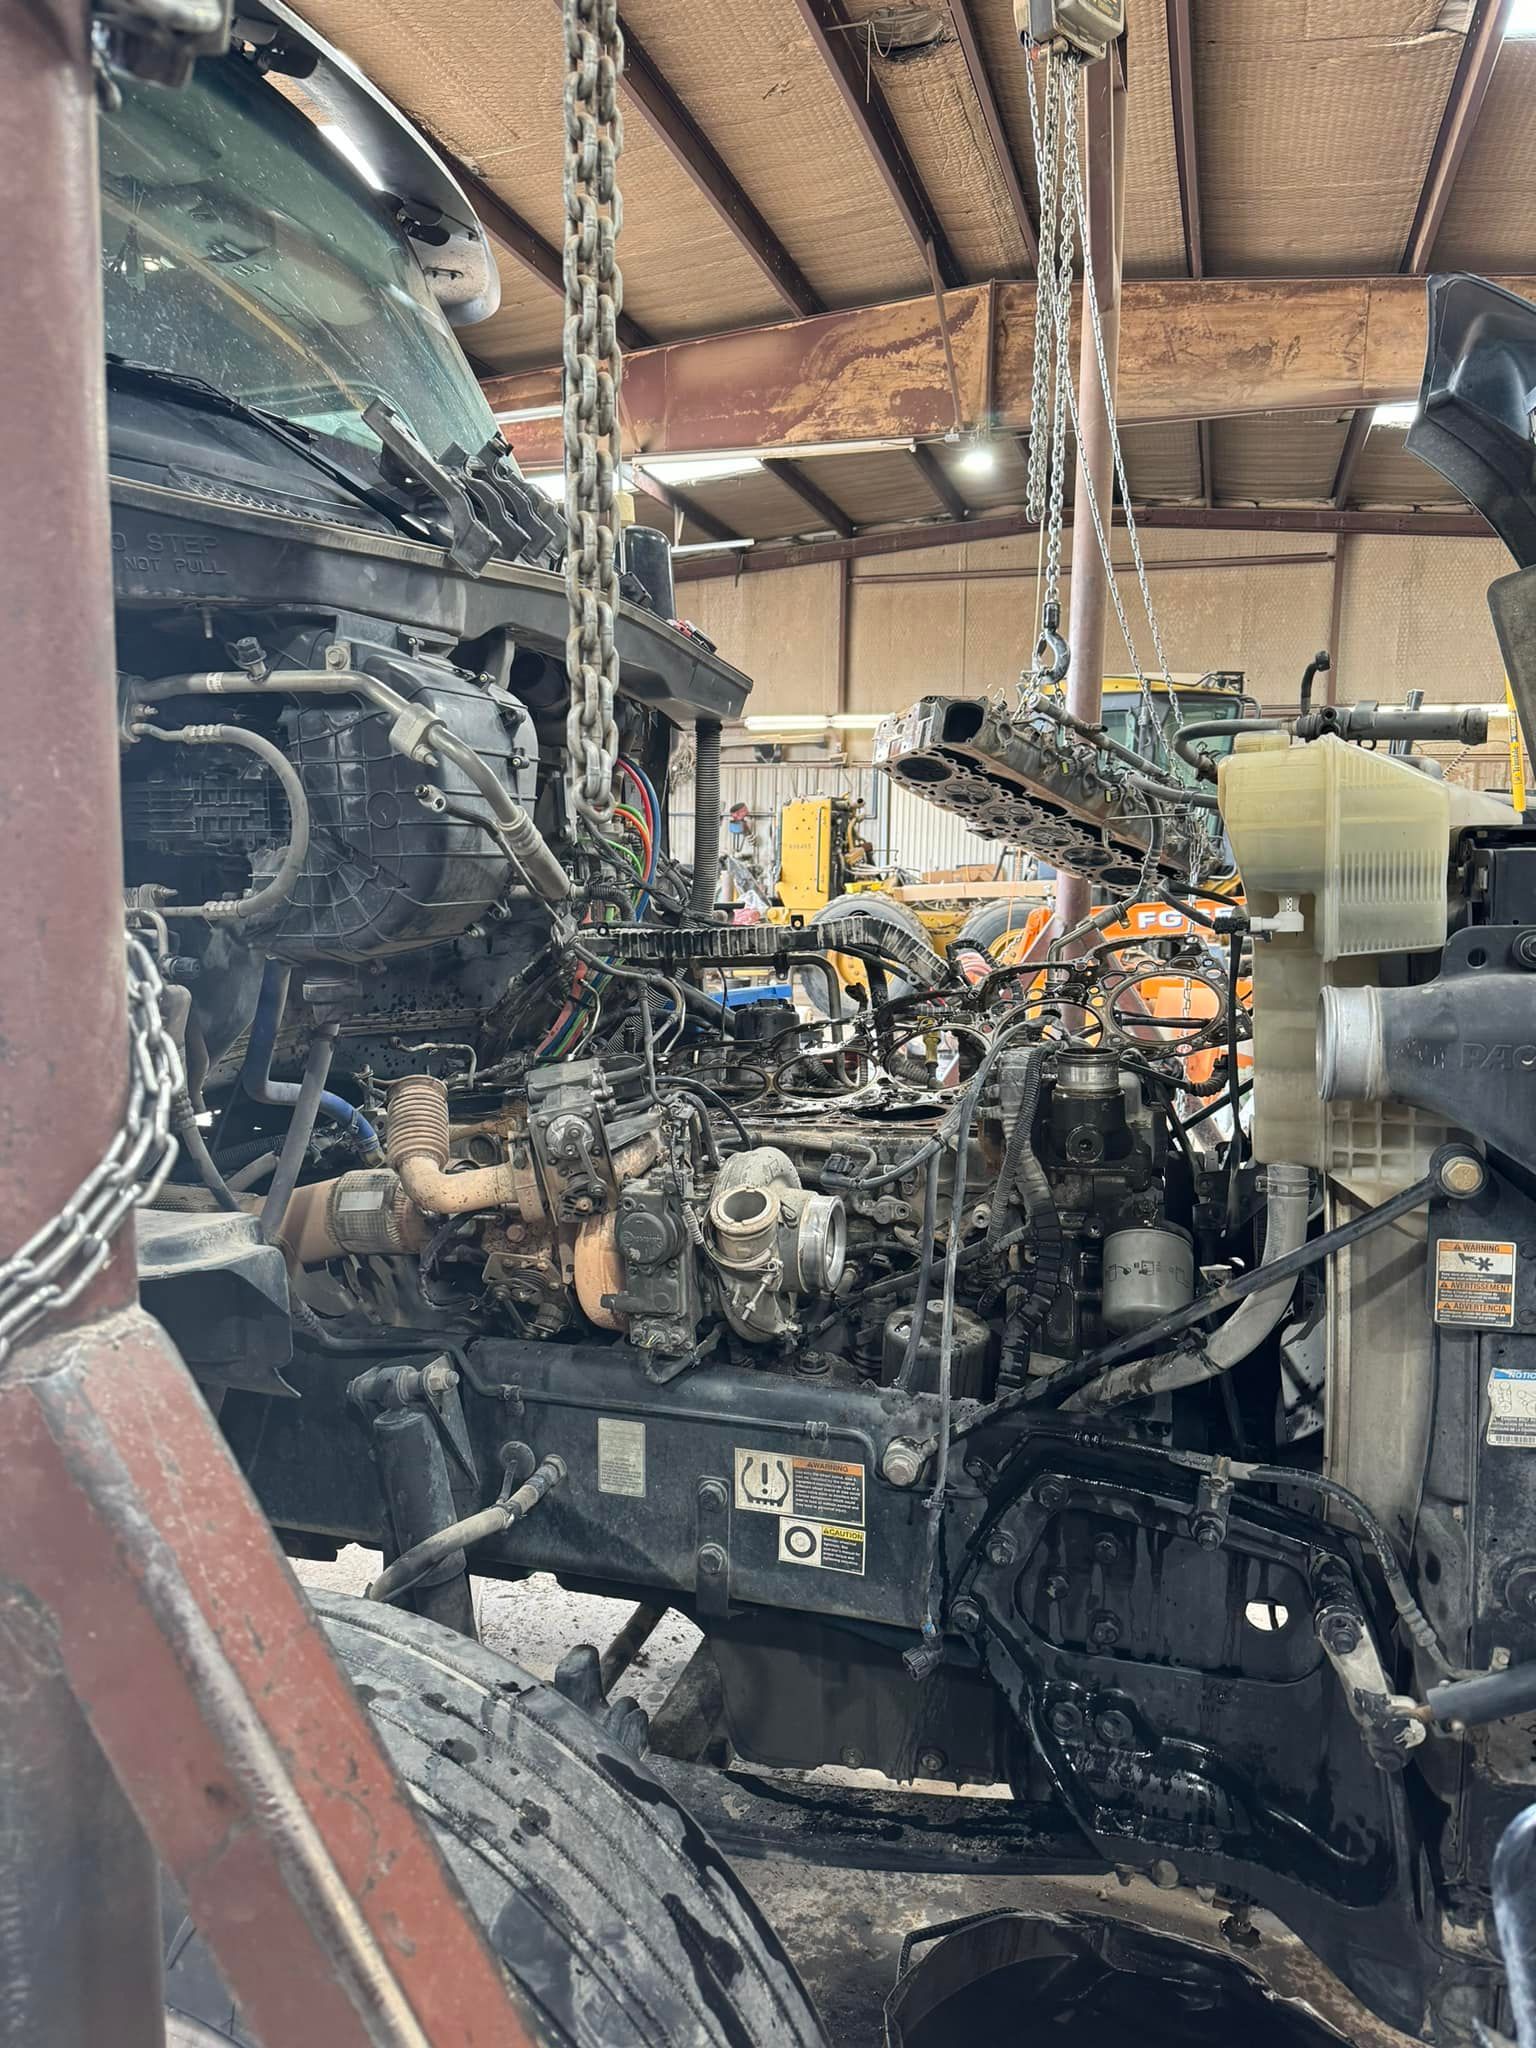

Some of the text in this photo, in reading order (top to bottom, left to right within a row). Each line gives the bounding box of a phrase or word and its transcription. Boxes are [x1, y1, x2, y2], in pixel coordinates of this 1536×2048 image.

[146, 532, 217, 556] STEP
[123, 556, 229, 575] NOT PULL
[1463, 1243, 1500, 1253] WARNING
[1450, 1282, 1510, 1292] AVERTISSEMENT
[1453, 1302, 1506, 1312] ADVERTENCIA
[812, 1462, 849, 1473] WARNING
[829, 1528, 863, 1540] CAUTION
